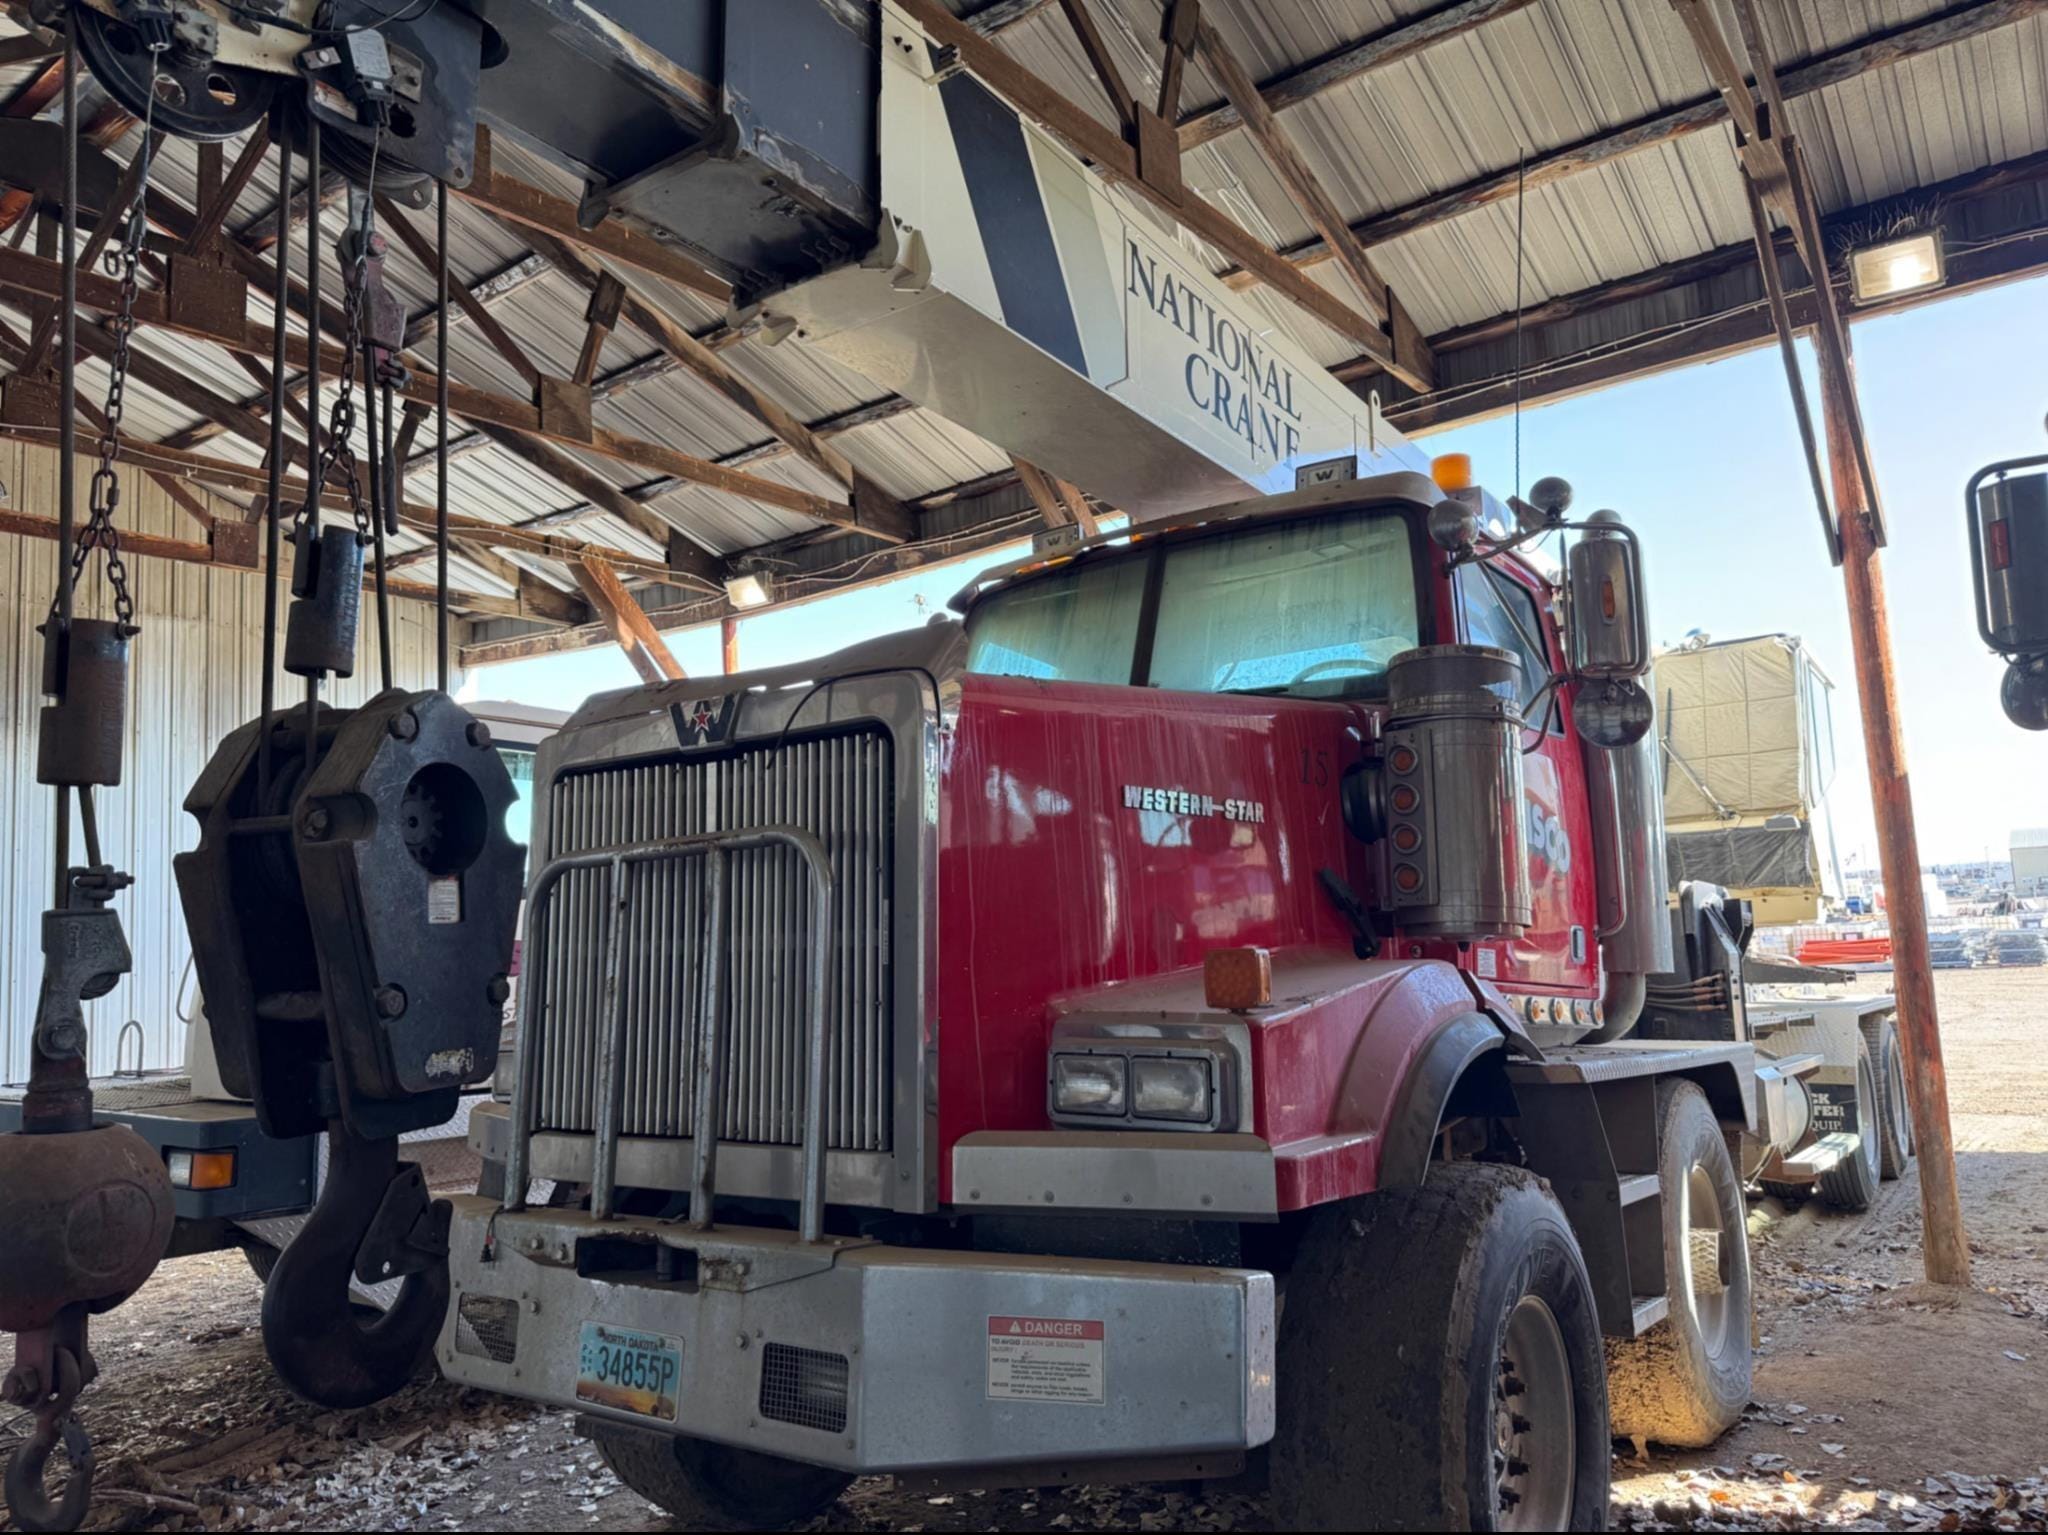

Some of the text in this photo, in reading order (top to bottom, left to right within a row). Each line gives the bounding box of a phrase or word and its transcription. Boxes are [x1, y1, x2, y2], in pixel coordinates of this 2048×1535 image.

[1127, 238, 1302, 422] NATIONAL
[1299, 748, 1330, 787] 15
[628, 1337, 659, 1351] DAKOTA
[1024, 1321, 1083, 1336] DANGER
[597, 1345, 675, 1395] 34855P
